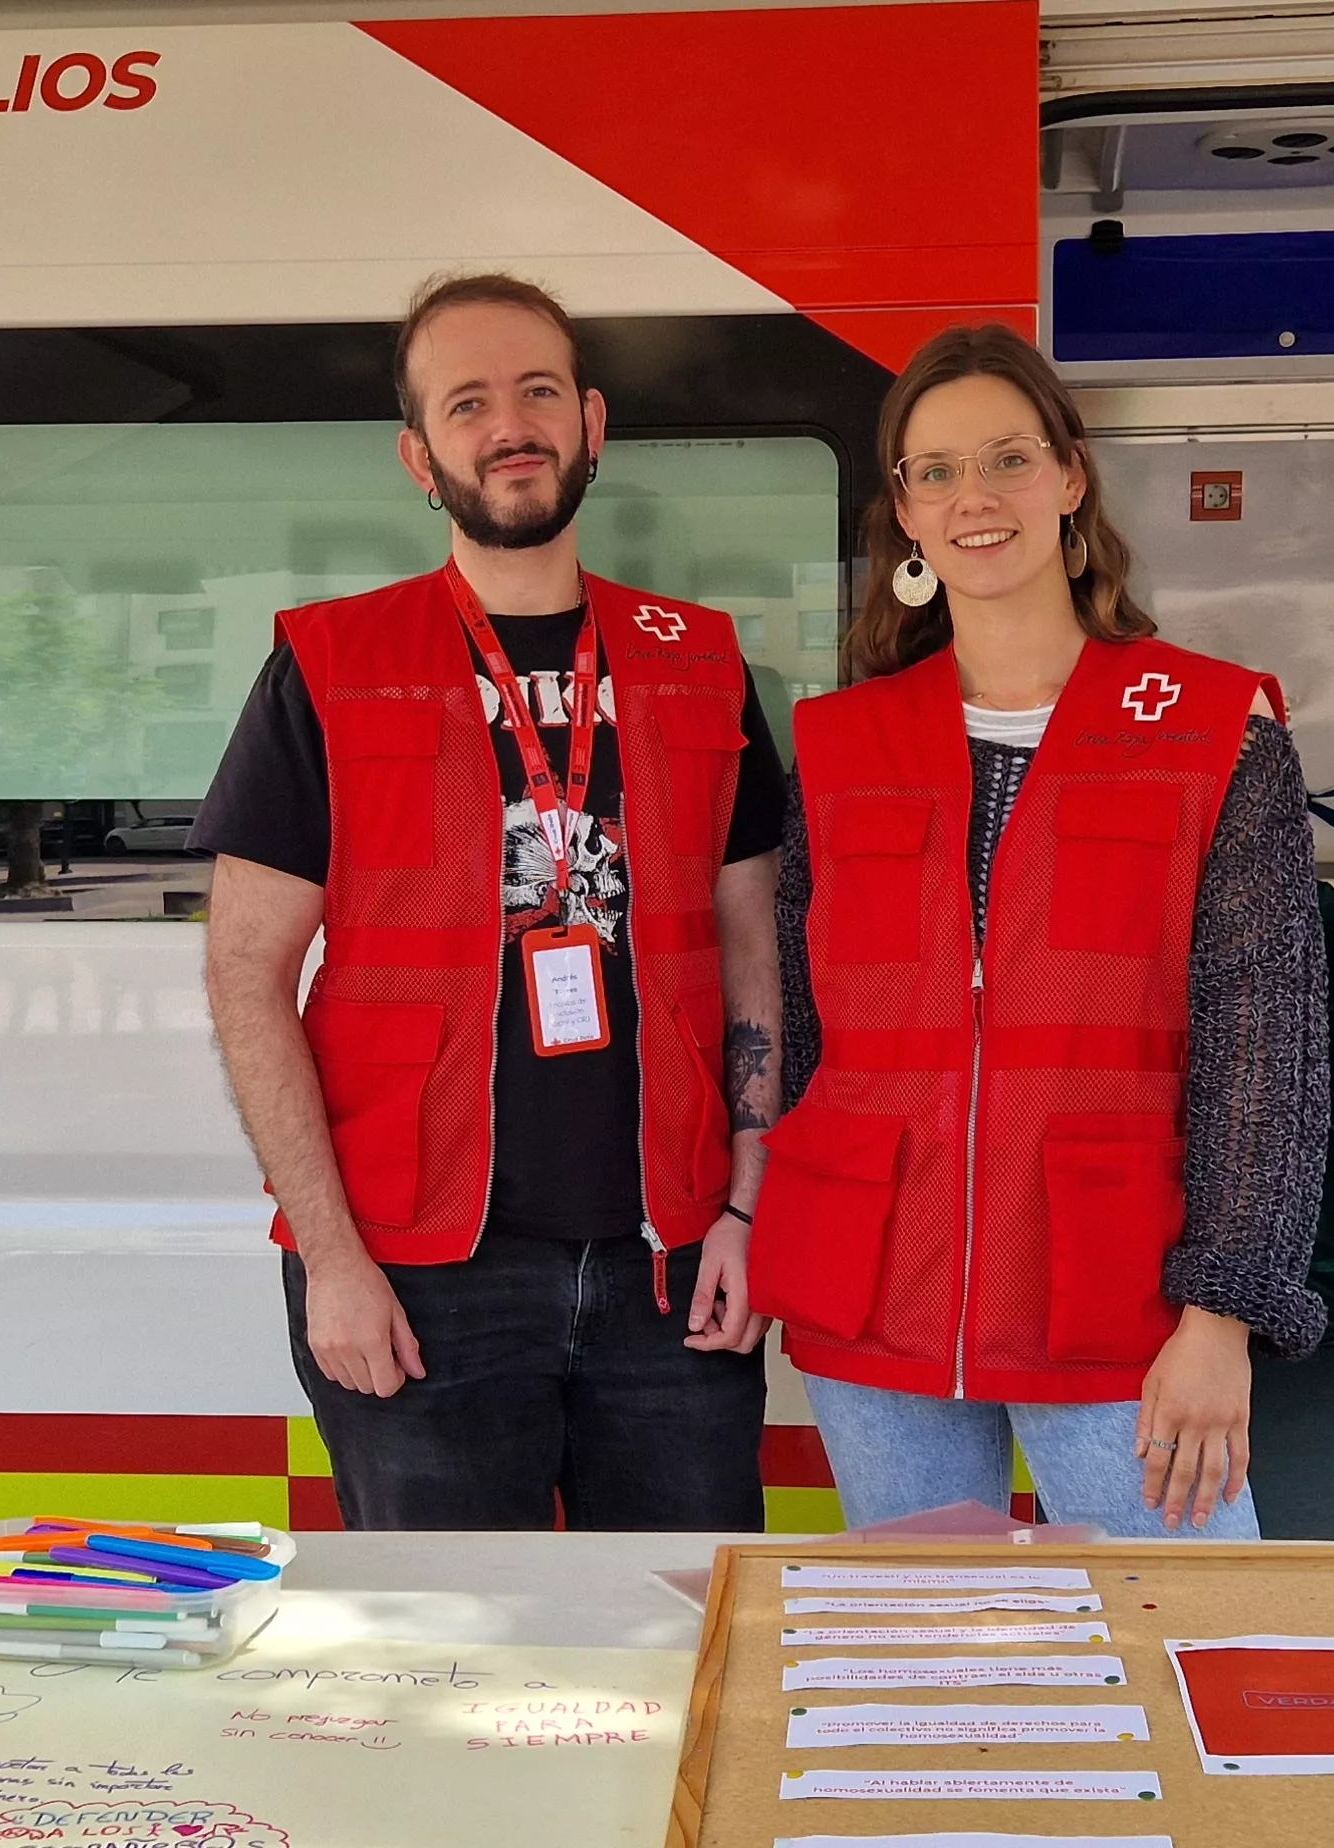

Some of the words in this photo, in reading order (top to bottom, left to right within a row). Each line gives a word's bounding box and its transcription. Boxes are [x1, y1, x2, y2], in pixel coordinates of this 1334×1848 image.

[230, 1708, 271, 1721] No
[462, 1701, 664, 1715] IGUALDAD
[494, 1717, 593, 1733] PARA
[220, 1728, 255, 1738] sin
[465, 1729, 650, 1751] SIEMPRE
[46, 1776, 76, 1788] sin
[1038, 1787, 1068, 1795] que
